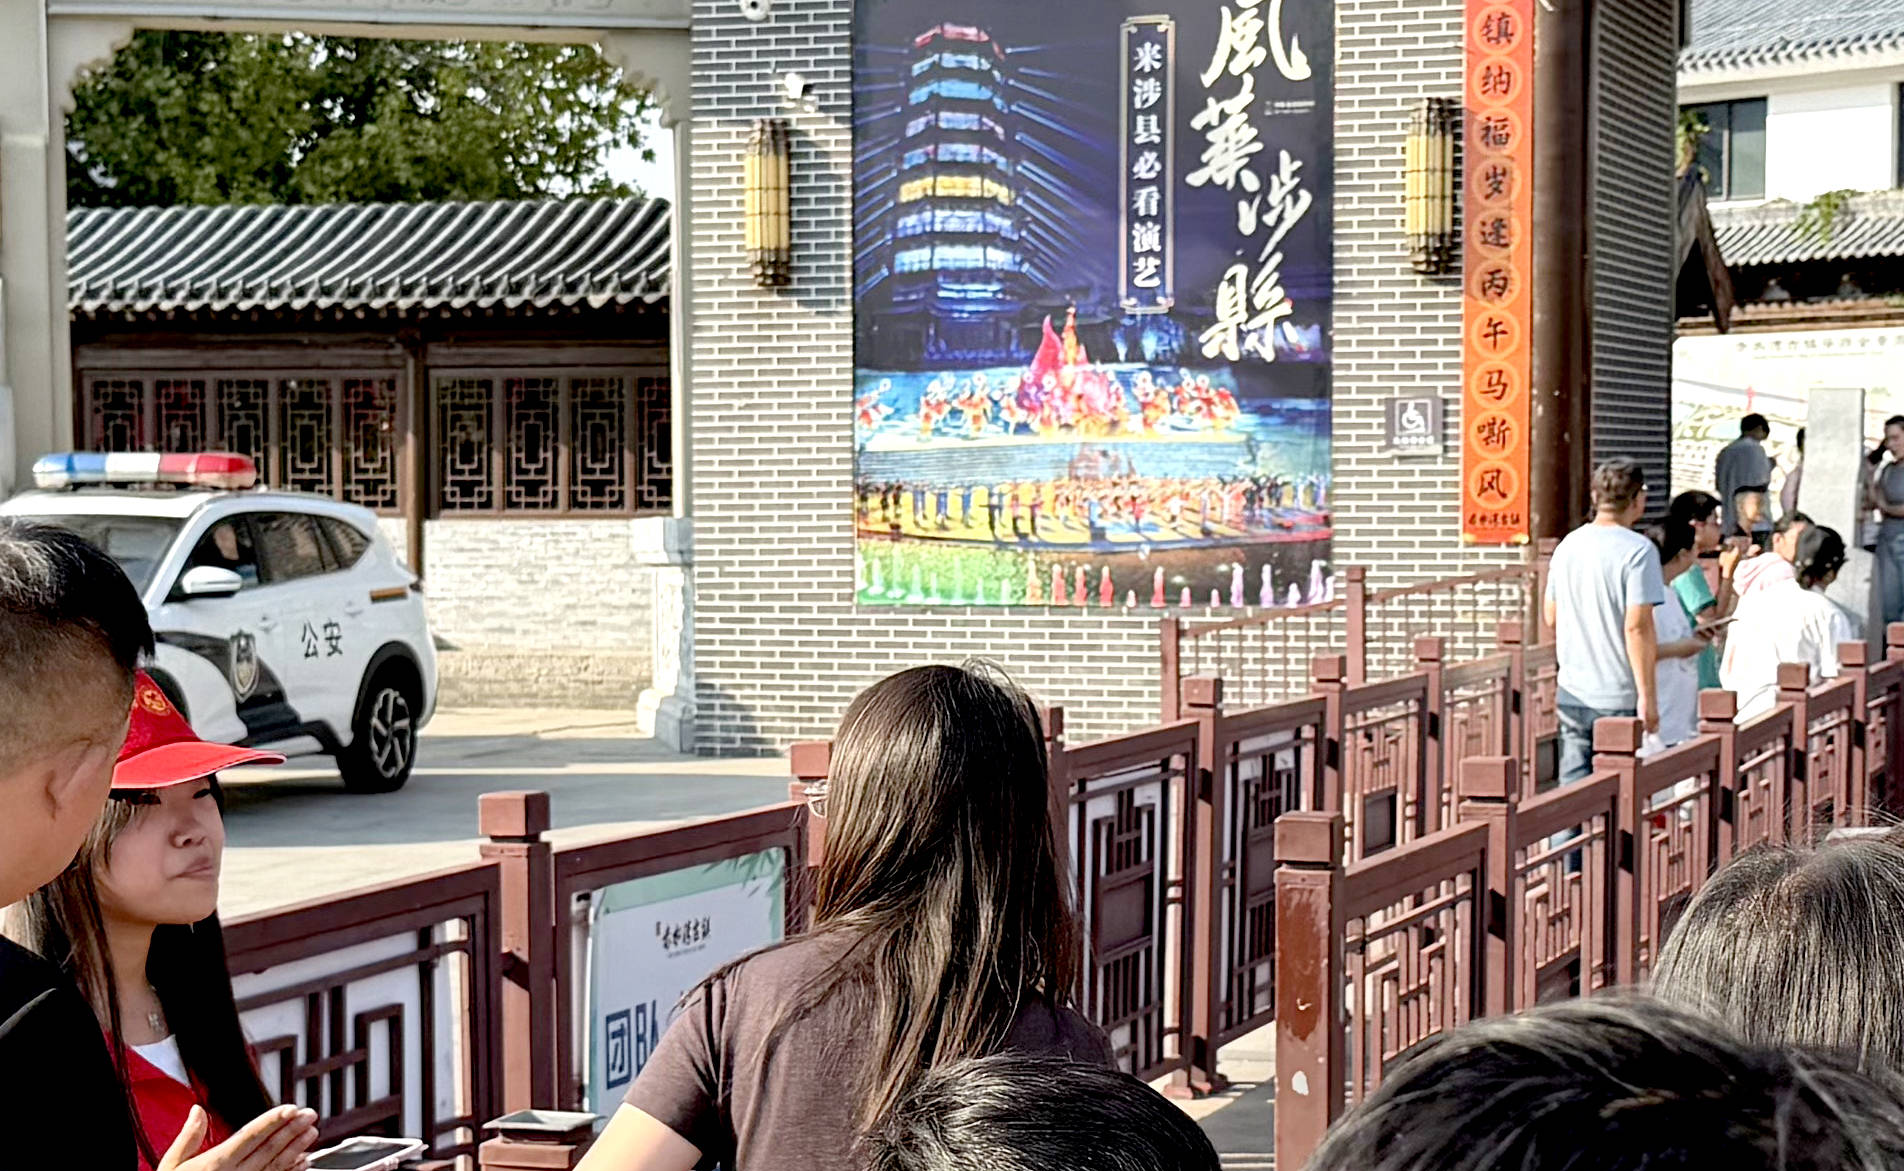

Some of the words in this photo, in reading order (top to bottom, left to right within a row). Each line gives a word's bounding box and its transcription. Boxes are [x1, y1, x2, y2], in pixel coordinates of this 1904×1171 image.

[1133, 42, 1162, 289] 来涉县必看演艺
[301, 619, 343, 658] 公安
